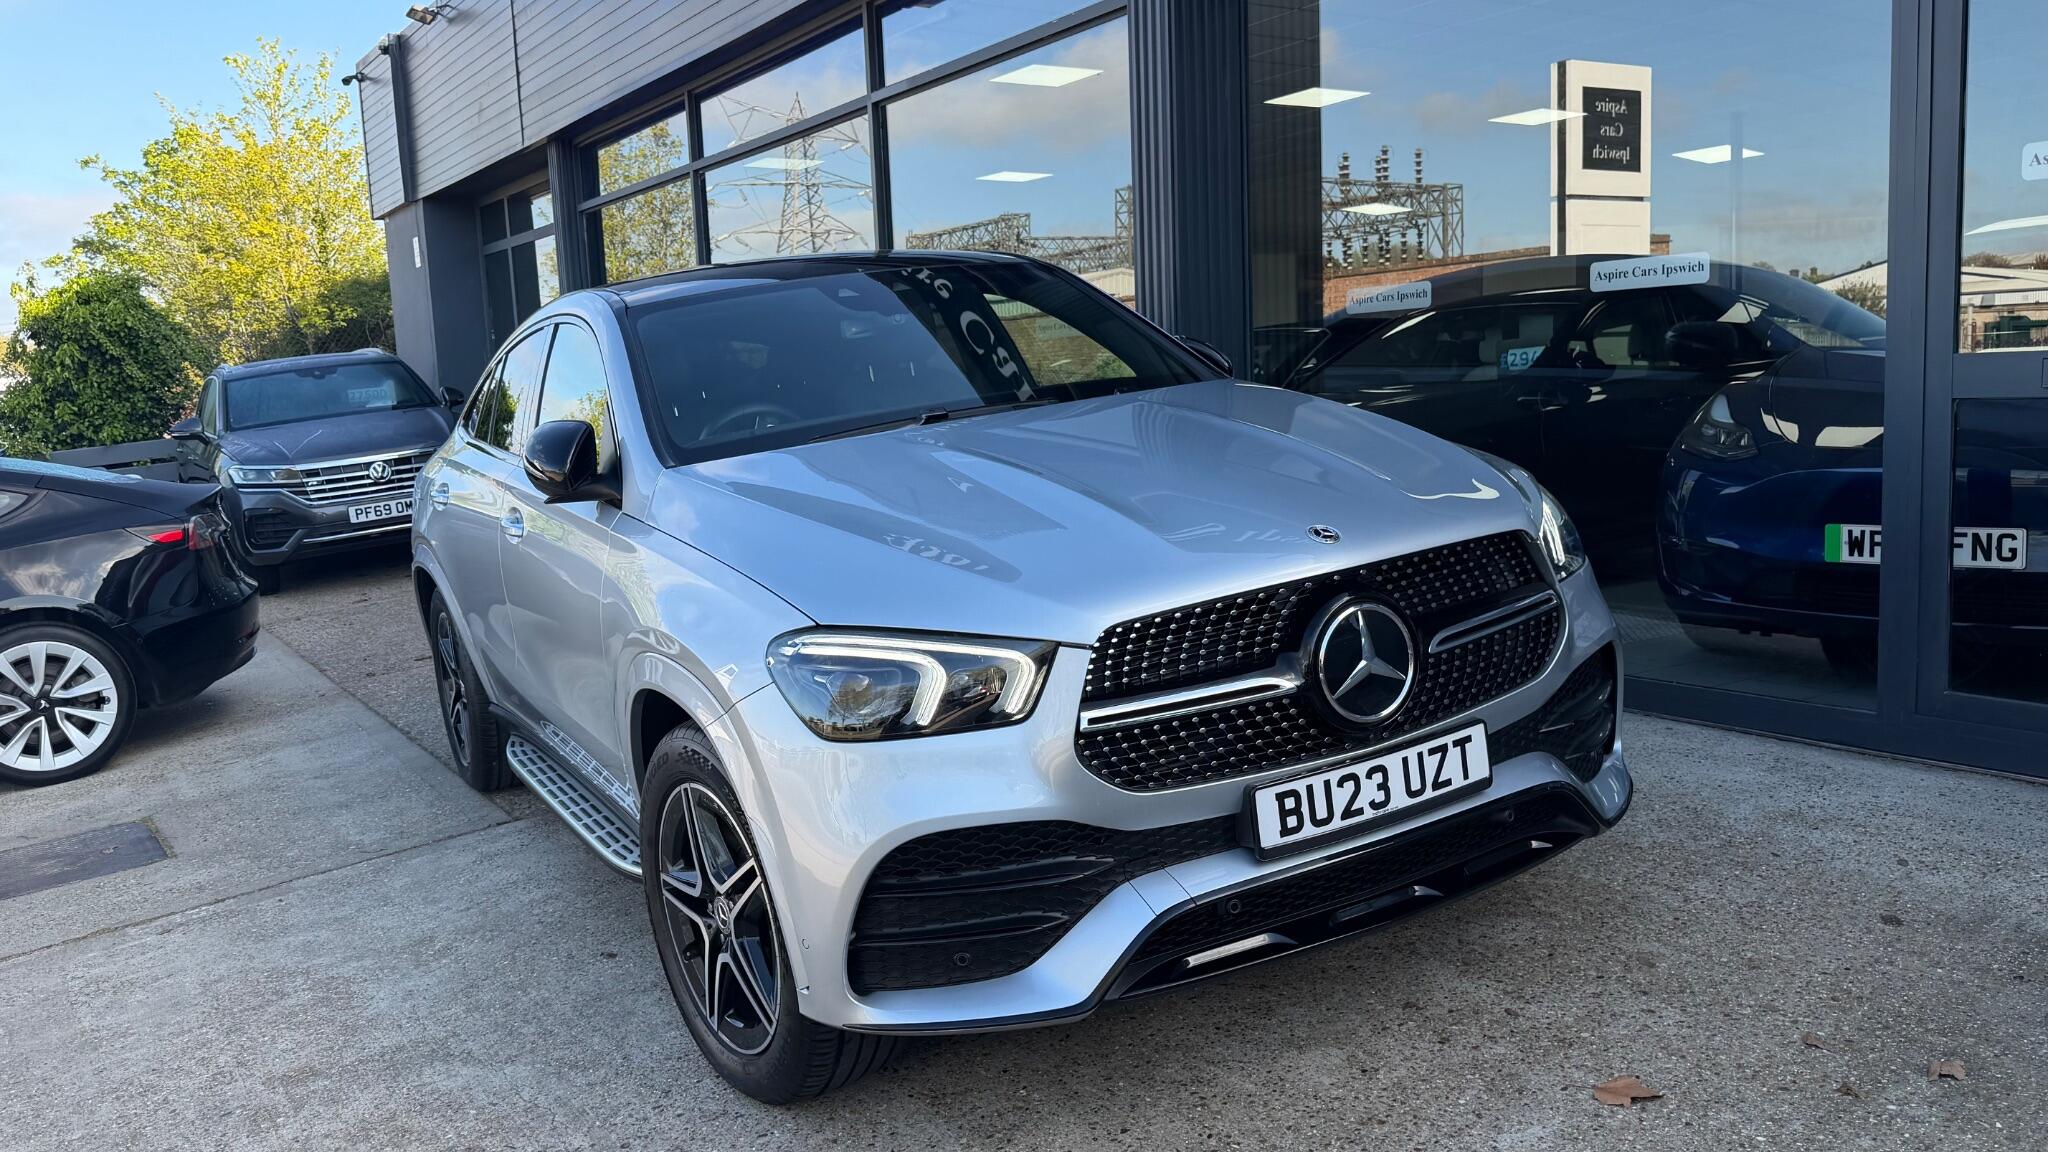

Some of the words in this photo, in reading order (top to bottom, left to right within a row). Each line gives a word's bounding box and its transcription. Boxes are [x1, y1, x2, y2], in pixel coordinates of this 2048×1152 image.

[1594, 268, 1629, 283] Aspire
[1632, 266, 1658, 278] Cars
[1661, 261, 1705, 277] Ipswich
[1350, 295, 1374, 307] Aspire
[1375, 293, 1395, 303] Cars
[1397, 289, 1428, 303] Ipswich
[355, 504, 392, 520] PF69
[1954, 532, 2018, 562] FNG
[1275, 764, 1392, 838] BU23
[1401, 734, 1473, 799] UZT
